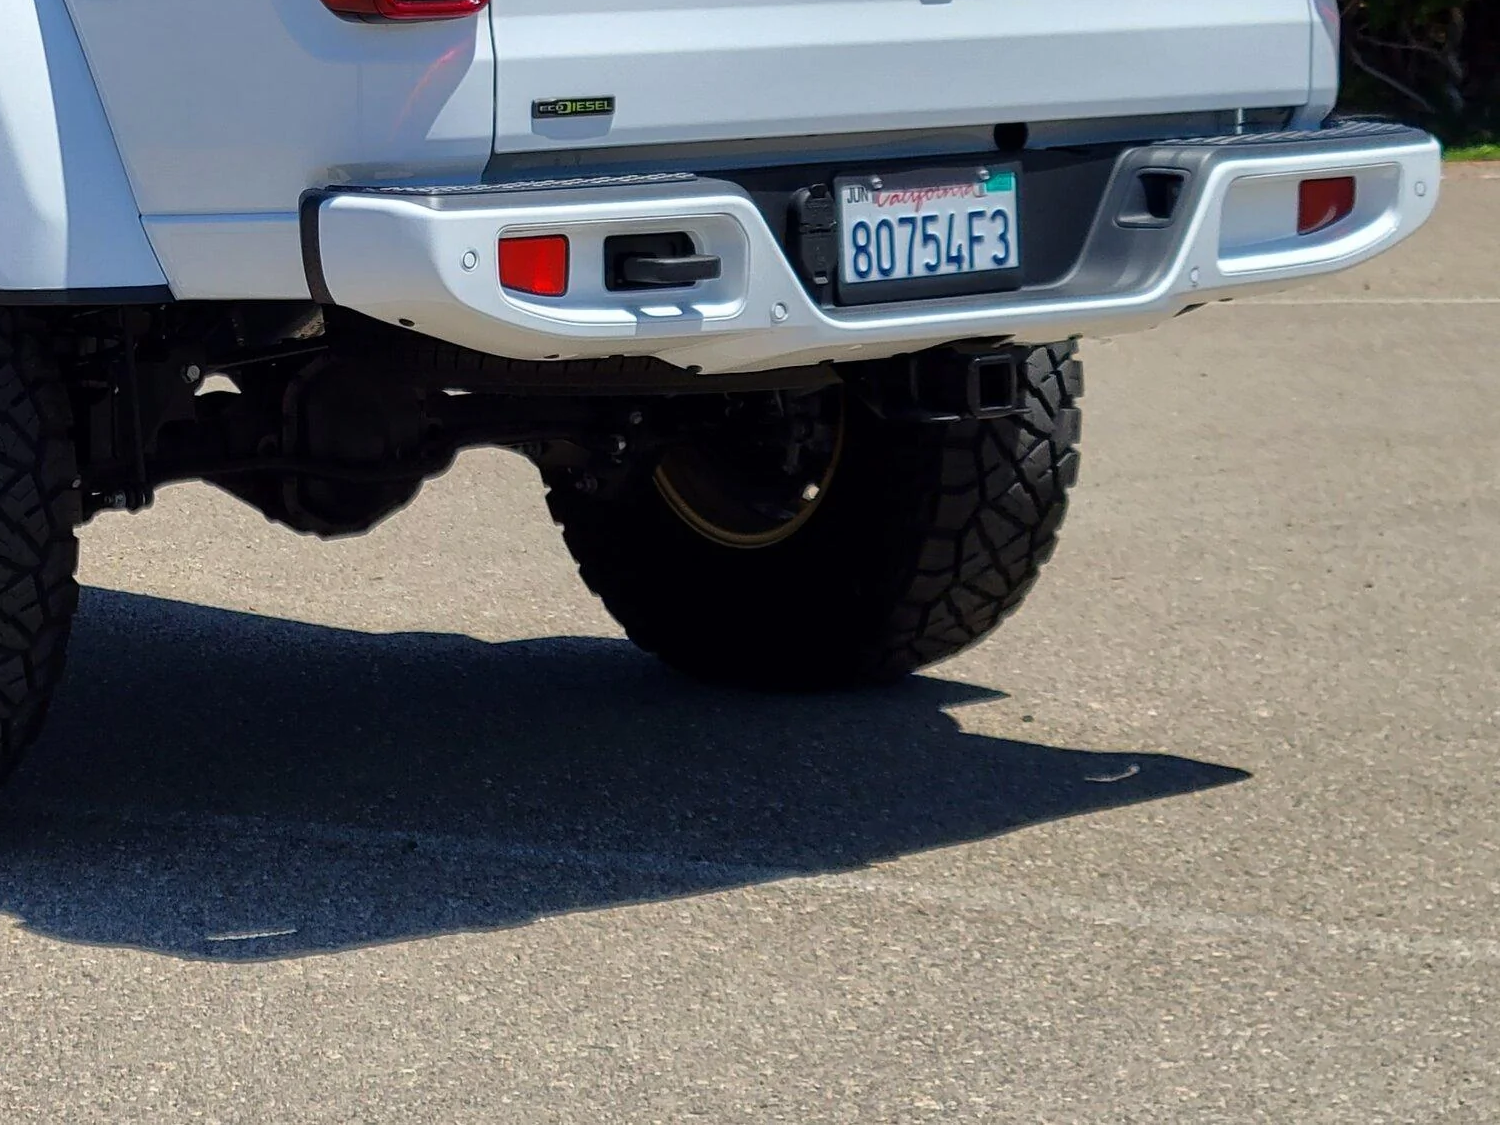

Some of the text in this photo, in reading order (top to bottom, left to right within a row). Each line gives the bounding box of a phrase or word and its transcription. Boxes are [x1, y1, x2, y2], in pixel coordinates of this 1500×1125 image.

[539, 100, 612, 114] ECODIESEL
[847, 186, 869, 203] JUN
[851, 208, 1010, 279] 80754F3
